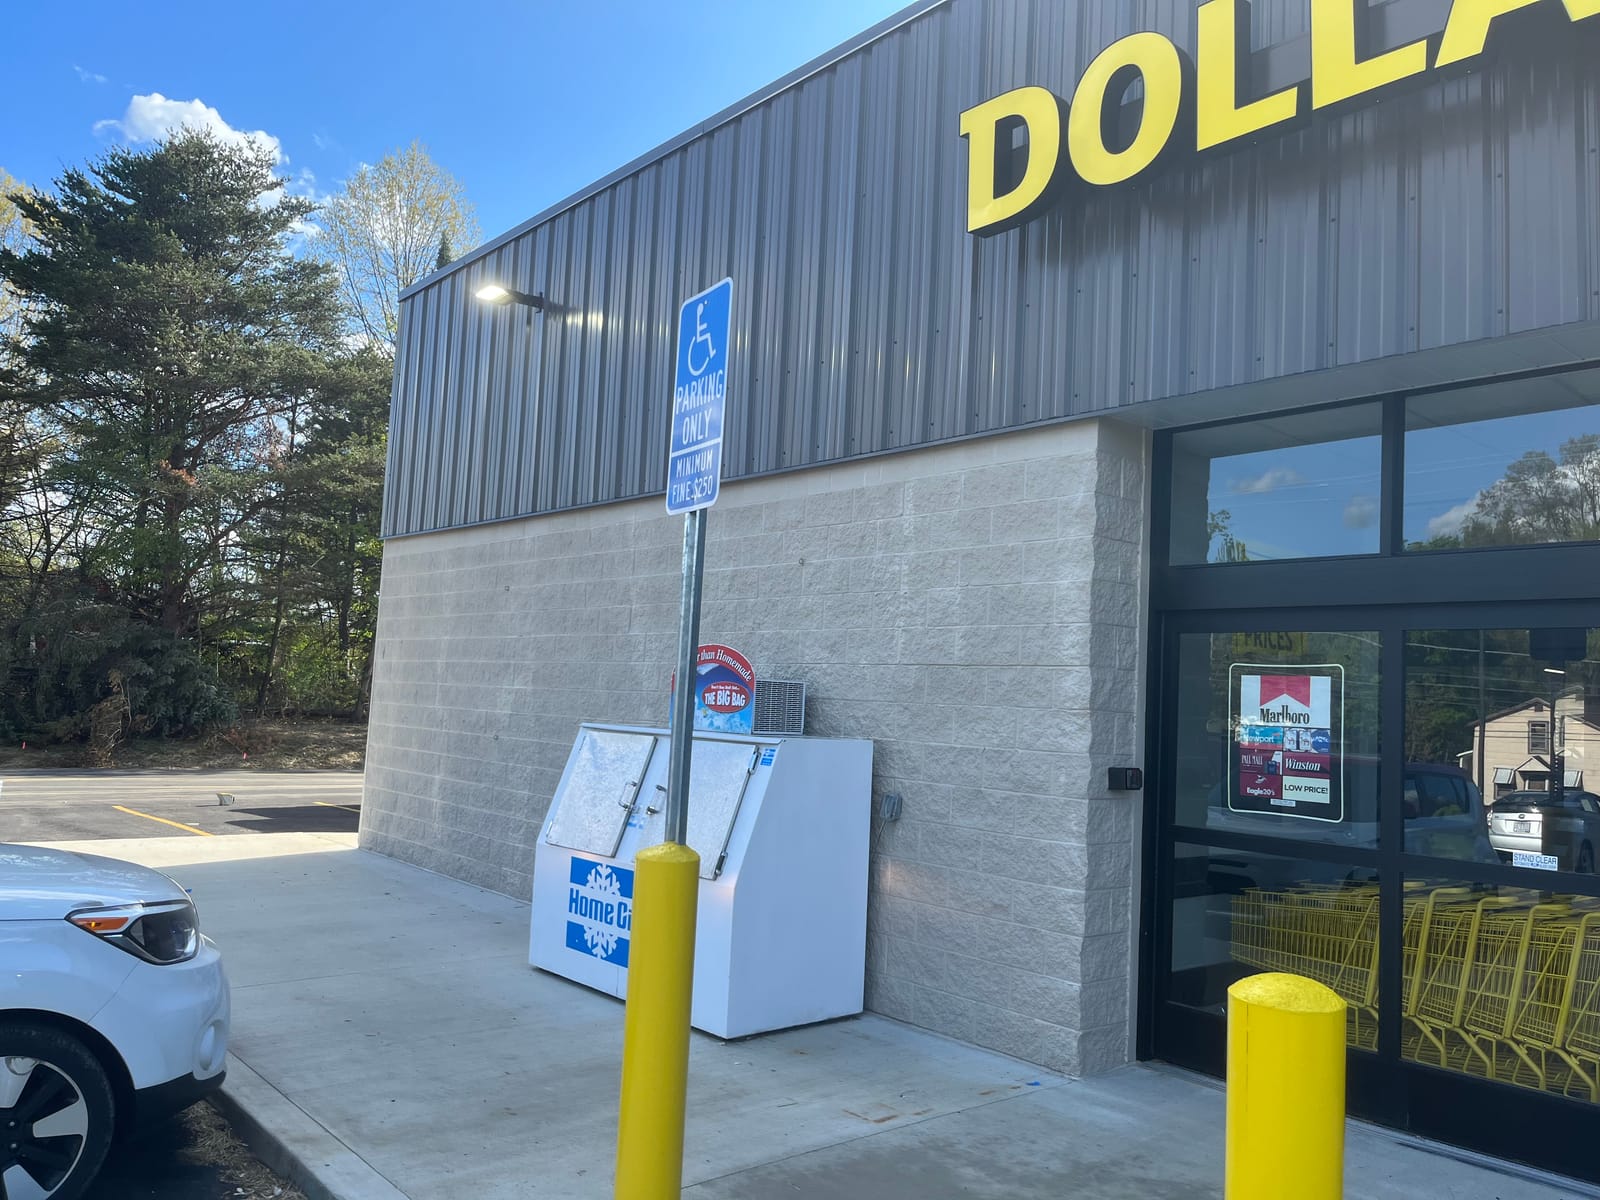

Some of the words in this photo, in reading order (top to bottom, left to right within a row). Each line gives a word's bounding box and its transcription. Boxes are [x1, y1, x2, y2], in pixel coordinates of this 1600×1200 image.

[959, 0, 1600, 233] DOLL
[676, 369, 723, 415] PARKING
[682, 408, 713, 445] ONLY
[676, 449, 713, 479] MINIMUM
[672, 480, 691, 504] FINE
[693, 475, 713, 502] $250
[716, 649, 752, 682] Homemade
[705, 692, 716, 705] THE
[717, 690, 730, 706] BIG
[731, 692, 746, 706] BAG
[1260, 704, 1310, 724] Marlboro
[1285, 758, 1321, 771] Winston
[1284, 784, 1303, 792] LOW
[1304, 786, 1329, 794] PRICE!
[1513, 853, 1534, 862] STAND
[1535, 855, 1557, 865] CLEAR
[568, 887, 615, 926] Home
